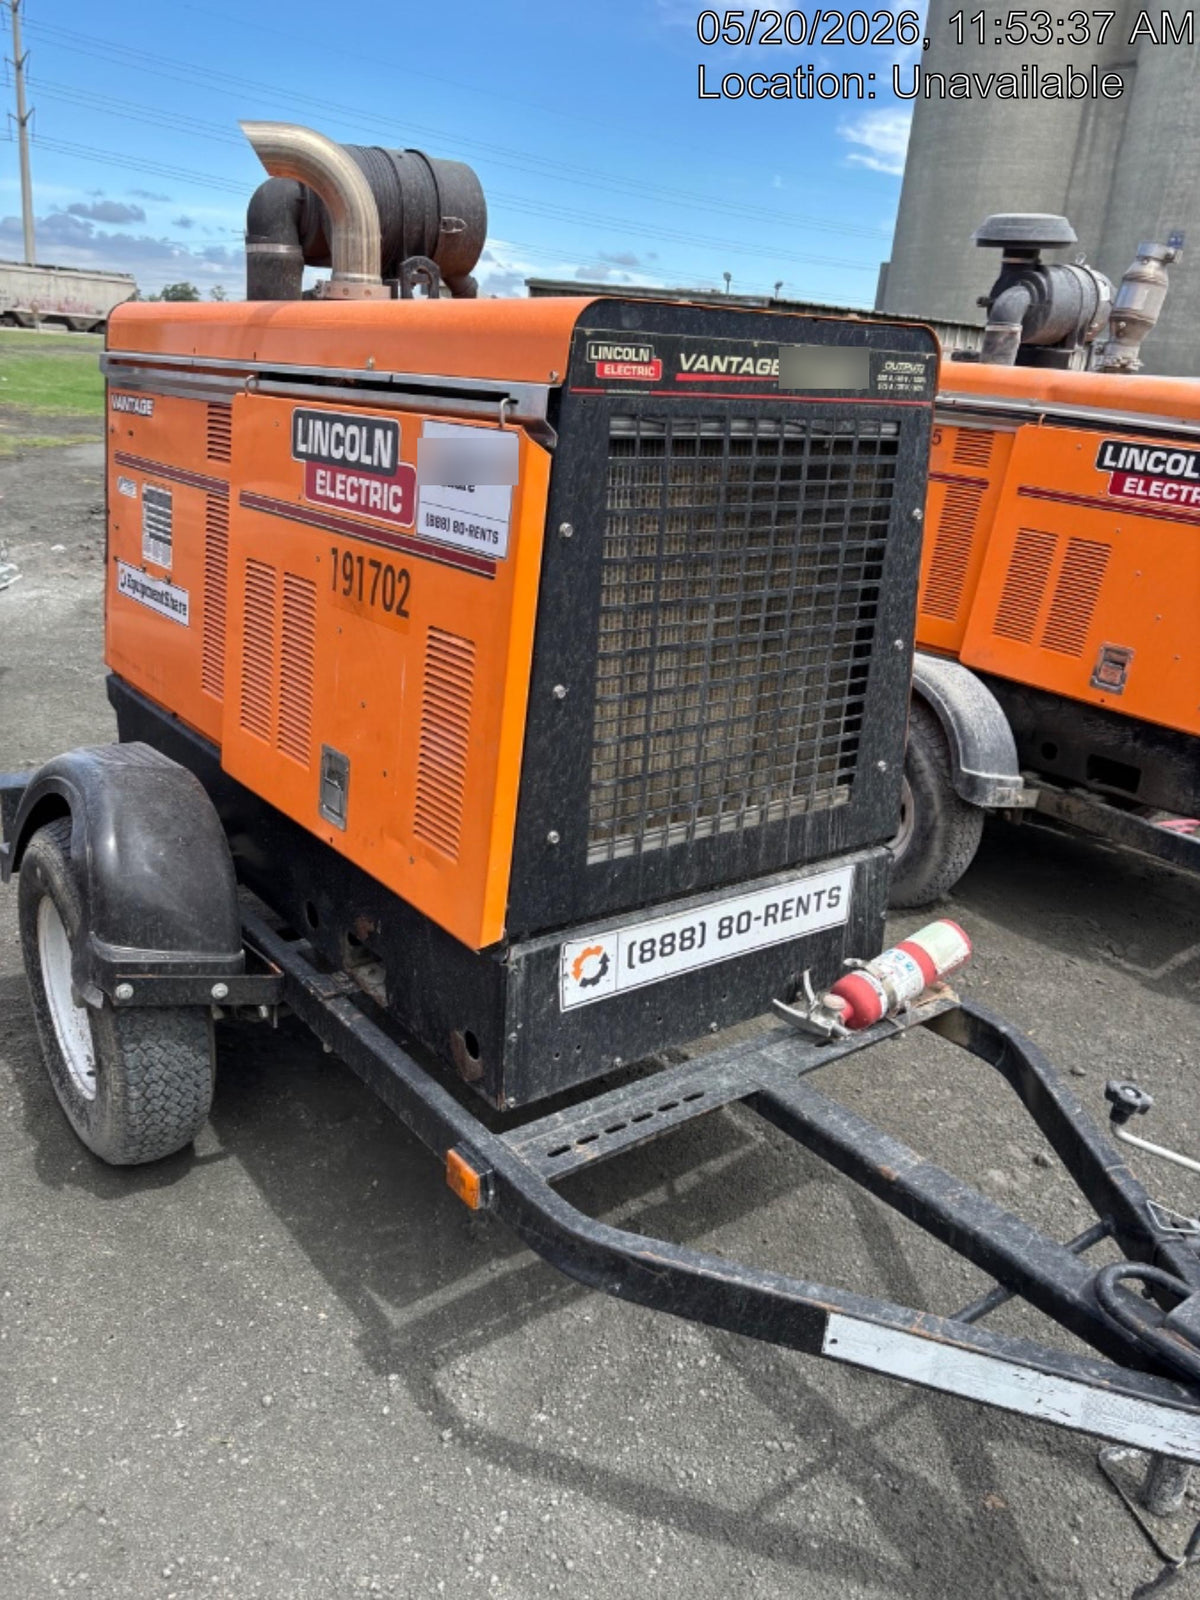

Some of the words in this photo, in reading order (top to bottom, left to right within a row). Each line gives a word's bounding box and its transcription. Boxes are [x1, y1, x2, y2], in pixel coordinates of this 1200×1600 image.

[590, 344, 650, 362] LINCOLN
[603, 364, 656, 377] ELECTRIC
[111, 394, 153, 415] VANTAGE
[296, 417, 393, 469] LINCOLN
[315, 469, 402, 514] ELECTRIC
[425, 512, 450, 532] (888)
[453, 520, 498, 544] 80-RENTS
[331, 547, 410, 618] 191702
[627, 921, 705, 969] (888)
[718, 886, 842, 940] 80-RENTS
